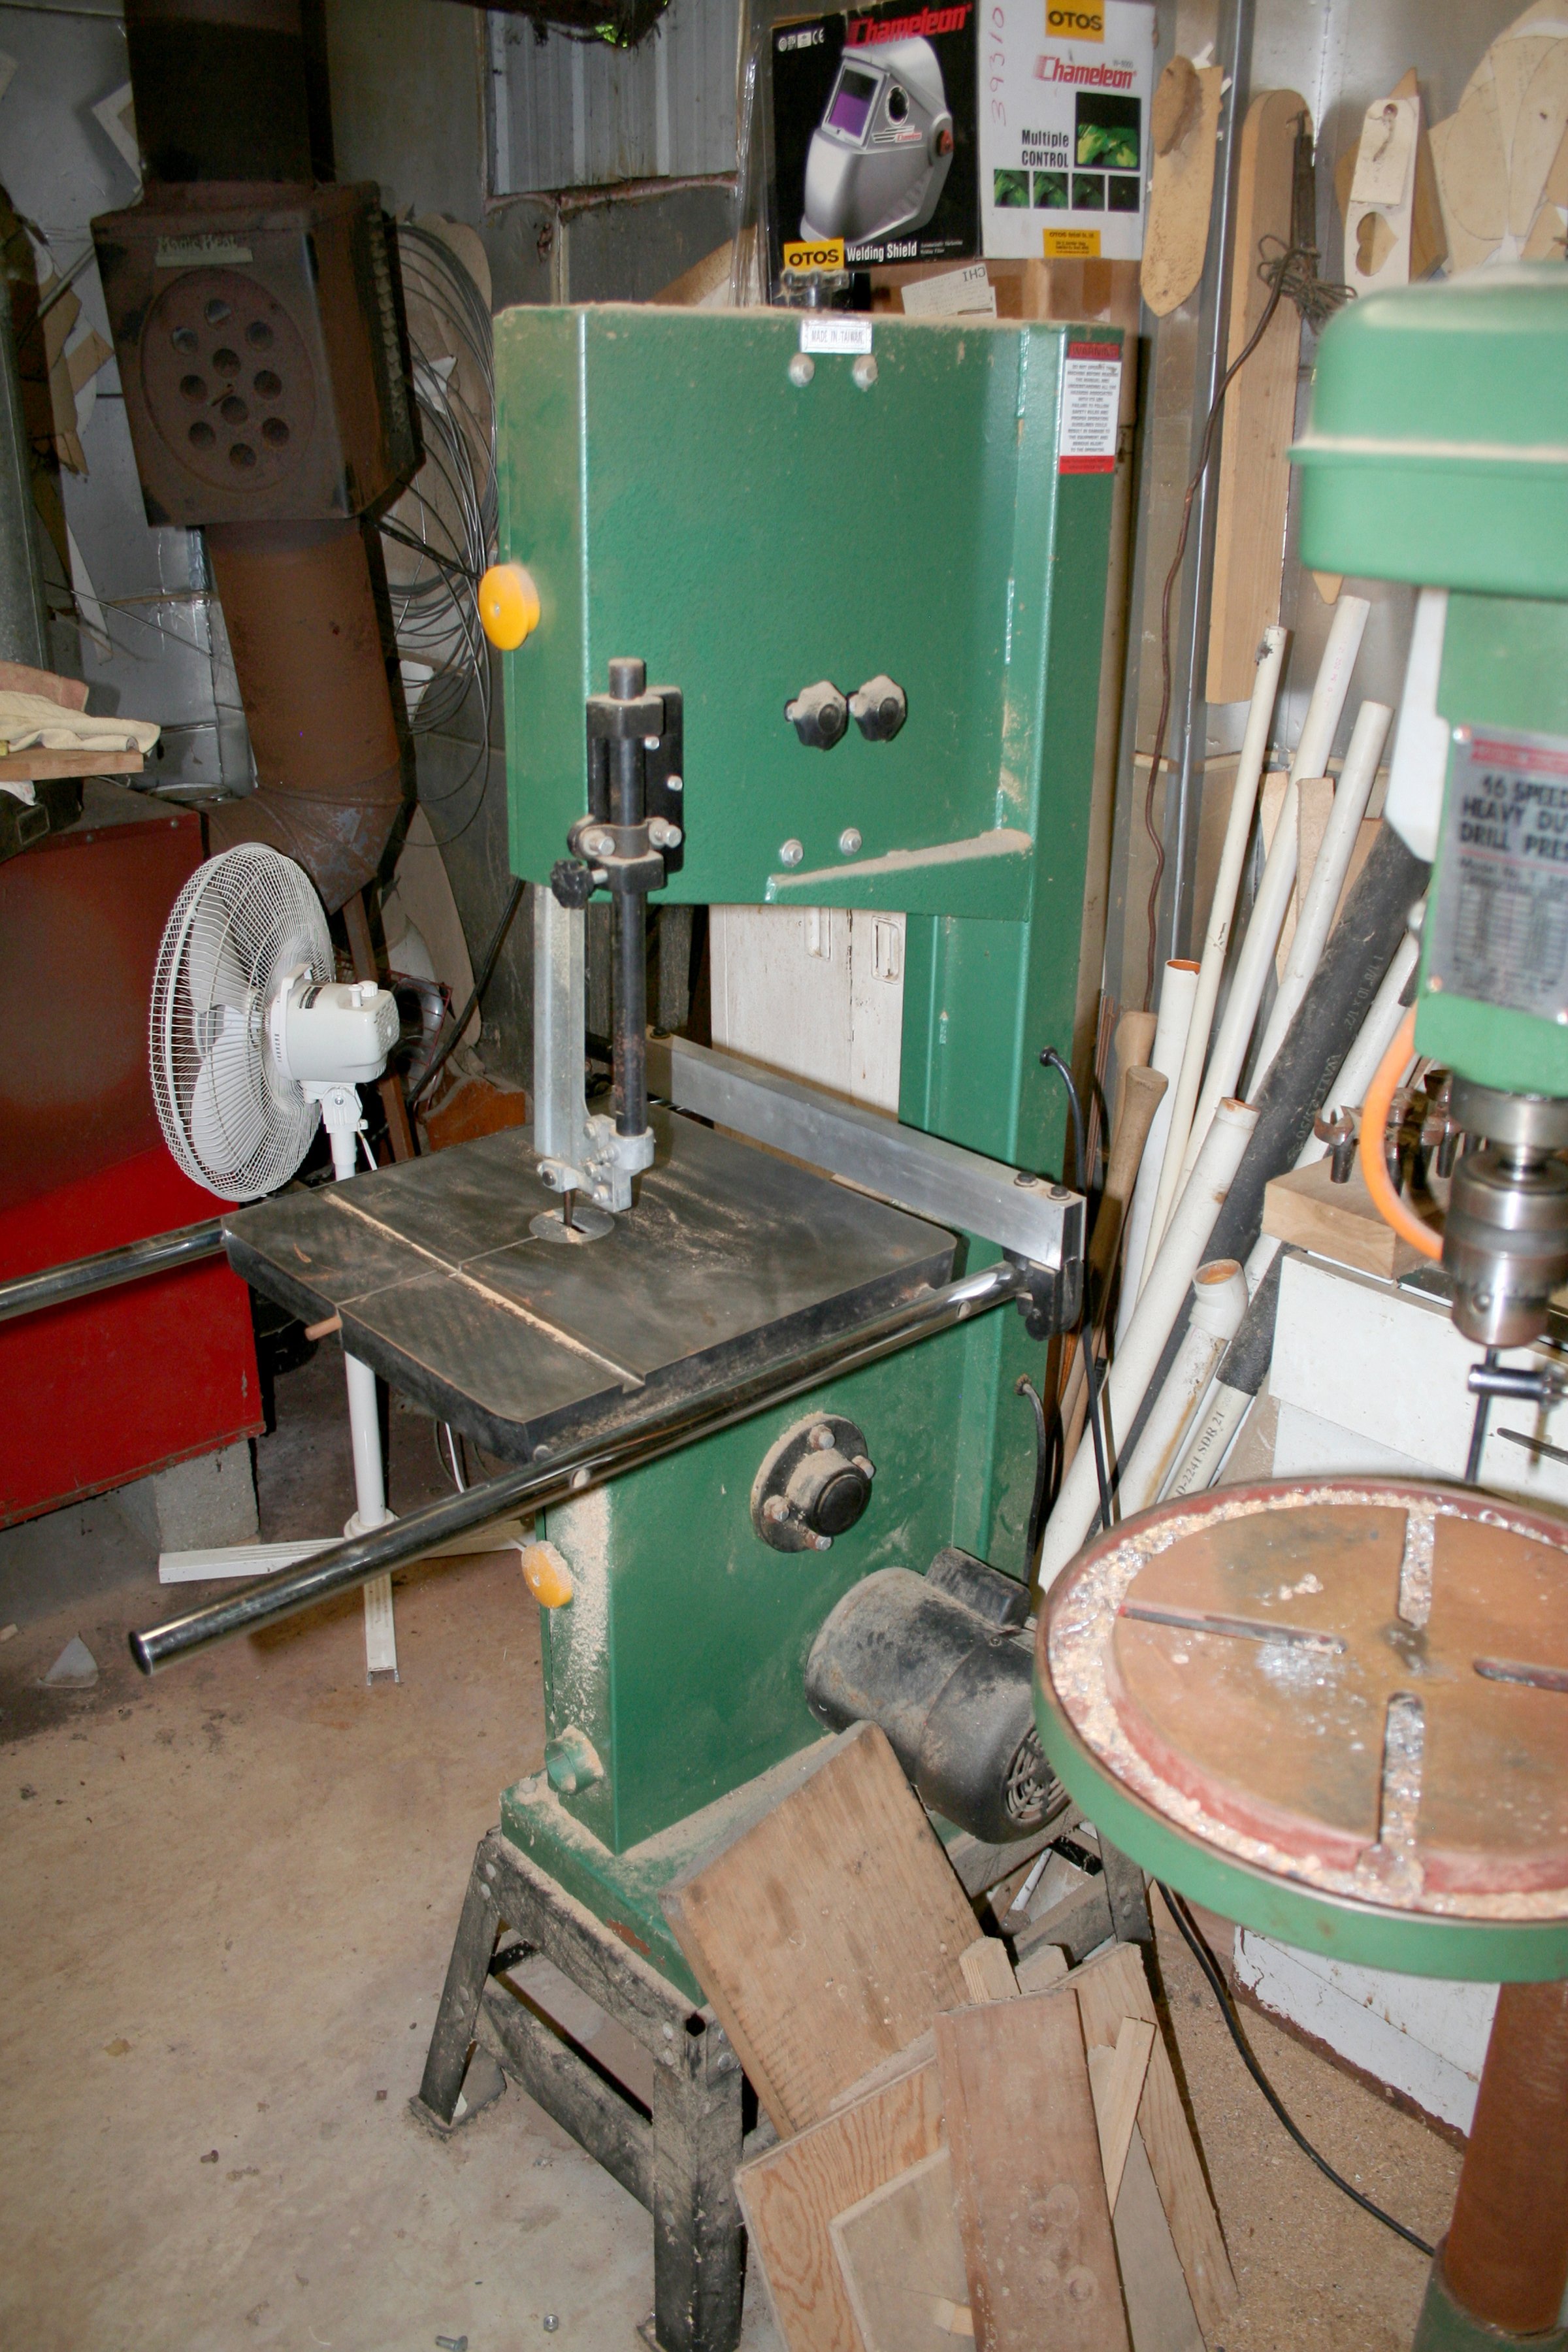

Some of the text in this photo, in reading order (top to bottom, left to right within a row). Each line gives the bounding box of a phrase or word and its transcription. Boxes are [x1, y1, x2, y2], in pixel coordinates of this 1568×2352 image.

[847, 6, 968, 49] Chameleon
[1049, 10, 1103, 31] OTOS
[1034, 55, 1134, 90] Chameleon
[1022, 129, 1069, 148] Multiple
[1022, 150, 1069, 168] CONTROL
[789, 249, 840, 267] OTOS
[847, 241, 917, 262] Welding Shield
[811, 330, 828, 343] MADE
[831, 331, 837, 343] IN
[1462, 794, 1525, 826] HEAVY
[1460, 821, 1511, 851] DRILL
[1198, 1426, 1217, 1454] SDR
[1212, 1411, 1225, 1426] 21
